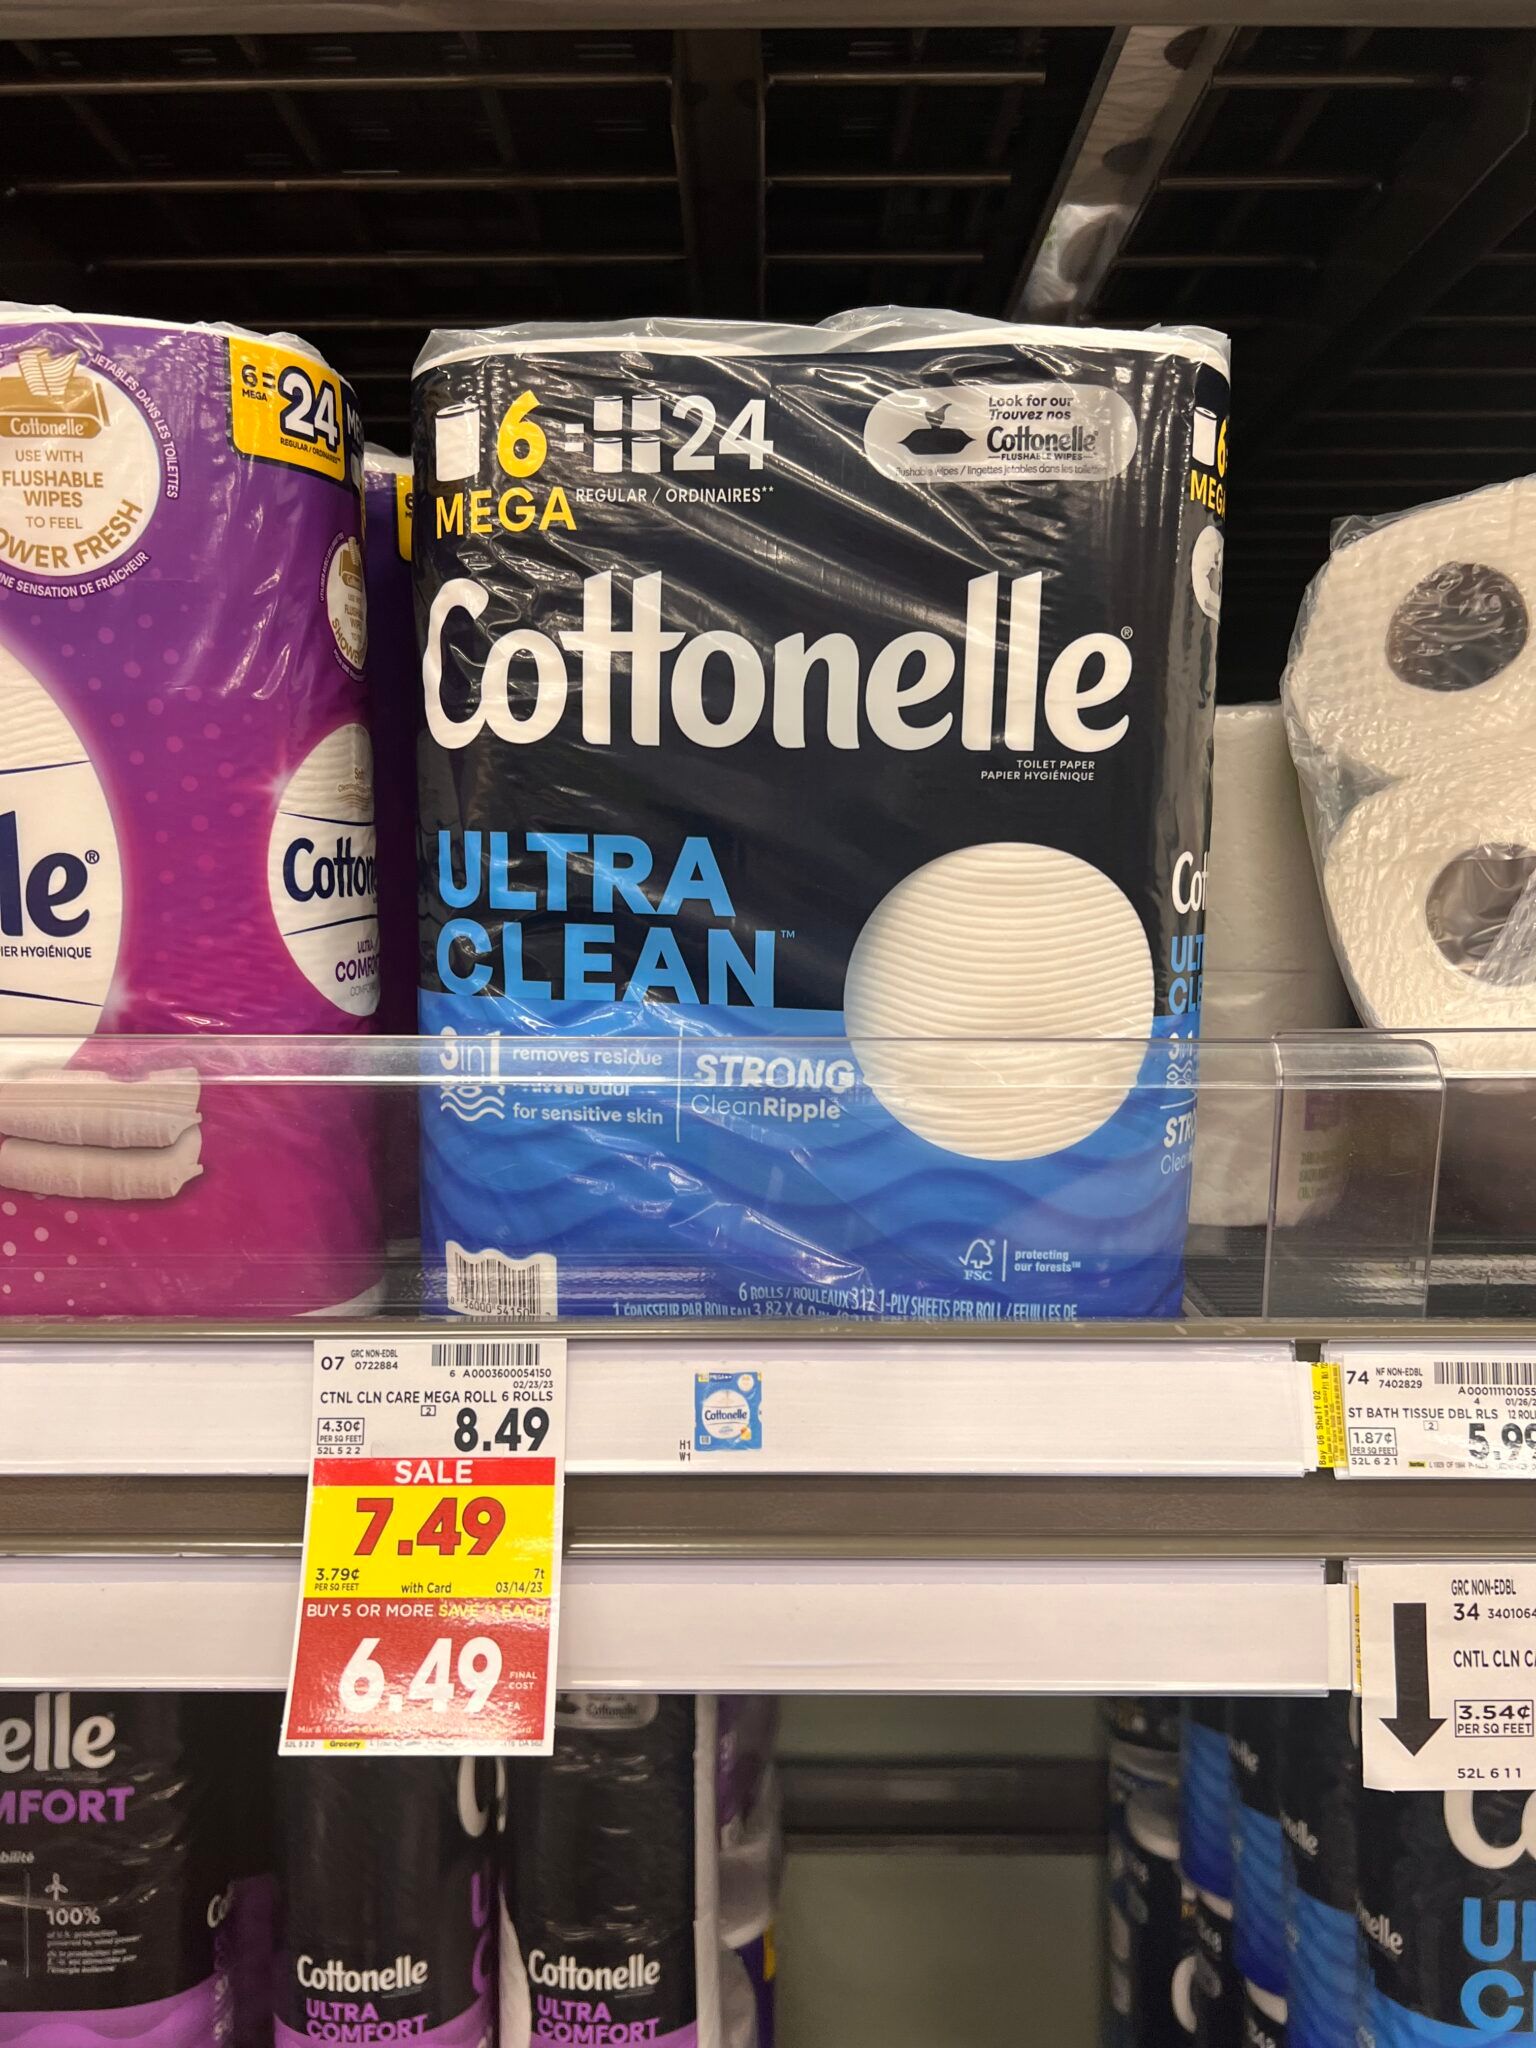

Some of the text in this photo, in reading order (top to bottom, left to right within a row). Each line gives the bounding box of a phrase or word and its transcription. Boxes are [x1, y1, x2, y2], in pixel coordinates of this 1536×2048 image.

[242, 388, 267, 402] MEGA
[989, 395, 1073, 408] Look for our
[280, 368, 340, 451] 24
[989, 409, 1071, 421] Trouvez nos
[10, 417, 85, 436] Cottonelle
[91, 353, 179, 499] JETABLES DANS LES TOILETTES
[498, 389, 774, 478] 6 24
[280, 437, 308, 452] REGULAR
[15, 450, 83, 463] USE WITH
[1001, 453, 1083, 461] FLUSHABLE WIPES
[967, 464, 1060, 477] lingettes dans
[2, 470, 104, 488] FLUSHABLE
[23, 490, 83, 508] WIPES
[576, 487, 648, 503] REGULAR
[435, 486, 577, 540] MEGA
[25, 516, 83, 530] TO FEEL
[73, 499, 143, 565] FRESH
[16, 550, 150, 598] SENSATION DE FRAÎCHEUR
[1017, 760, 1096, 770] TOILET PAPER
[980, 769, 1095, 782] PAPIER HYGIÉNIQUE
[437, 831, 736, 918] ULTRA
[20, 944, 92, 959] HYGIÉNIQUE
[513, 1047, 663, 1066] removes residue
[695, 1054, 856, 1093] STRONG
[513, 1103, 664, 1125] for sensitive skin
[690, 1093, 842, 1123] CleanRipple
[1014, 1249, 1069, 1262] protecting
[1014, 1263, 1033, 1272] our
[964, 1270, 993, 1281] FSC
[464, 1299, 492, 1313] 36000
[738, 1281, 747, 1302] 6
[751, 1286, 784, 1299] ROLLS
[793, 1287, 850, 1308] ROULEAUX
[878, 1288, 910, 1316] 1-PLY
[911, 1295, 951, 1318] SHEETS
[320, 1349, 398, 1370] 07 GRC NON-EDBL
[354, 1361, 398, 1370] 0722884
[450, 1369, 552, 1378] 6 A0003600054150
[1346, 1367, 1424, 1385] 74 NF NON-EDBL
[513, 1380, 554, 1389] 02/23/23
[1379, 1380, 1422, 1389] 7402829
[320, 1391, 553, 1404] CTNL CLN CARE MEGA ROLL 6 ROLLS
[1473, 1398, 1480, 1406] 4
[425, 1407, 432, 1415] 2
[704, 1409, 748, 1421] Cottonelle
[1348, 1408, 1517, 1419] ST BATH TISSUE DBL RLS 12
[322, 1421, 361, 1433] 4.30¢
[454, 1406, 550, 1452] 8.49
[320, 1435, 362, 1443] PER SQ FEET
[1315, 1407, 1327, 1465] Bay Shelf
[1353, 1432, 1392, 1444] 1.87¢
[317, 1447, 361, 1455] 52L 5 2 2
[679, 1440, 691, 1450] H1
[1352, 1446, 1396, 1454] PER SQ FEET
[679, 1452, 691, 1461] W1
[1351, 1457, 1391, 1465] 52L 6 2
[393, 1459, 473, 1484] SALE
[353, 1495, 506, 1557] 7.49
[315, 1568, 360, 1581] 3.79¢
[534, 1569, 545, 1579] 7t
[314, 1583, 360, 1591] PER SQ FEET
[401, 1582, 452, 1593] with Card
[495, 1582, 543, 1593] 03/14/23
[1451, 1579, 1516, 1595] GRC NON-EDBL
[306, 1604, 341, 1618] BUY
[342, 1604, 351, 1617] 5
[356, 1604, 380, 1617] OR
[387, 1604, 434, 1617] MORE
[438, 1604, 479, 1617] SAVE
[501, 1603, 547, 1618] EACH
[1453, 1602, 1536, 1621] 34 3401064
[1453, 1650, 1520, 1667] CNTL CLN
[338, 1636, 503, 1714] 6.49
[510, 1671, 537, 1679] FINAL
[508, 1681, 534, 1690] COST
[1459, 1705, 1531, 1720] 3.54¢
[1457, 1723, 1531, 1735] PER SQ FEET
[1457, 1768, 1499, 1779] 52L 6
[46, 1906, 101, 1926] 100%
[297, 1953, 428, 1993] Cottonelle
[528, 1950, 661, 1992] Cottonelle
[306, 1997, 379, 2024] ULTRA
[536, 1994, 612, 2023] ULTRA
[306, 2013, 428, 2043] COMFORT
[536, 2017, 661, 2045] COMFORT
